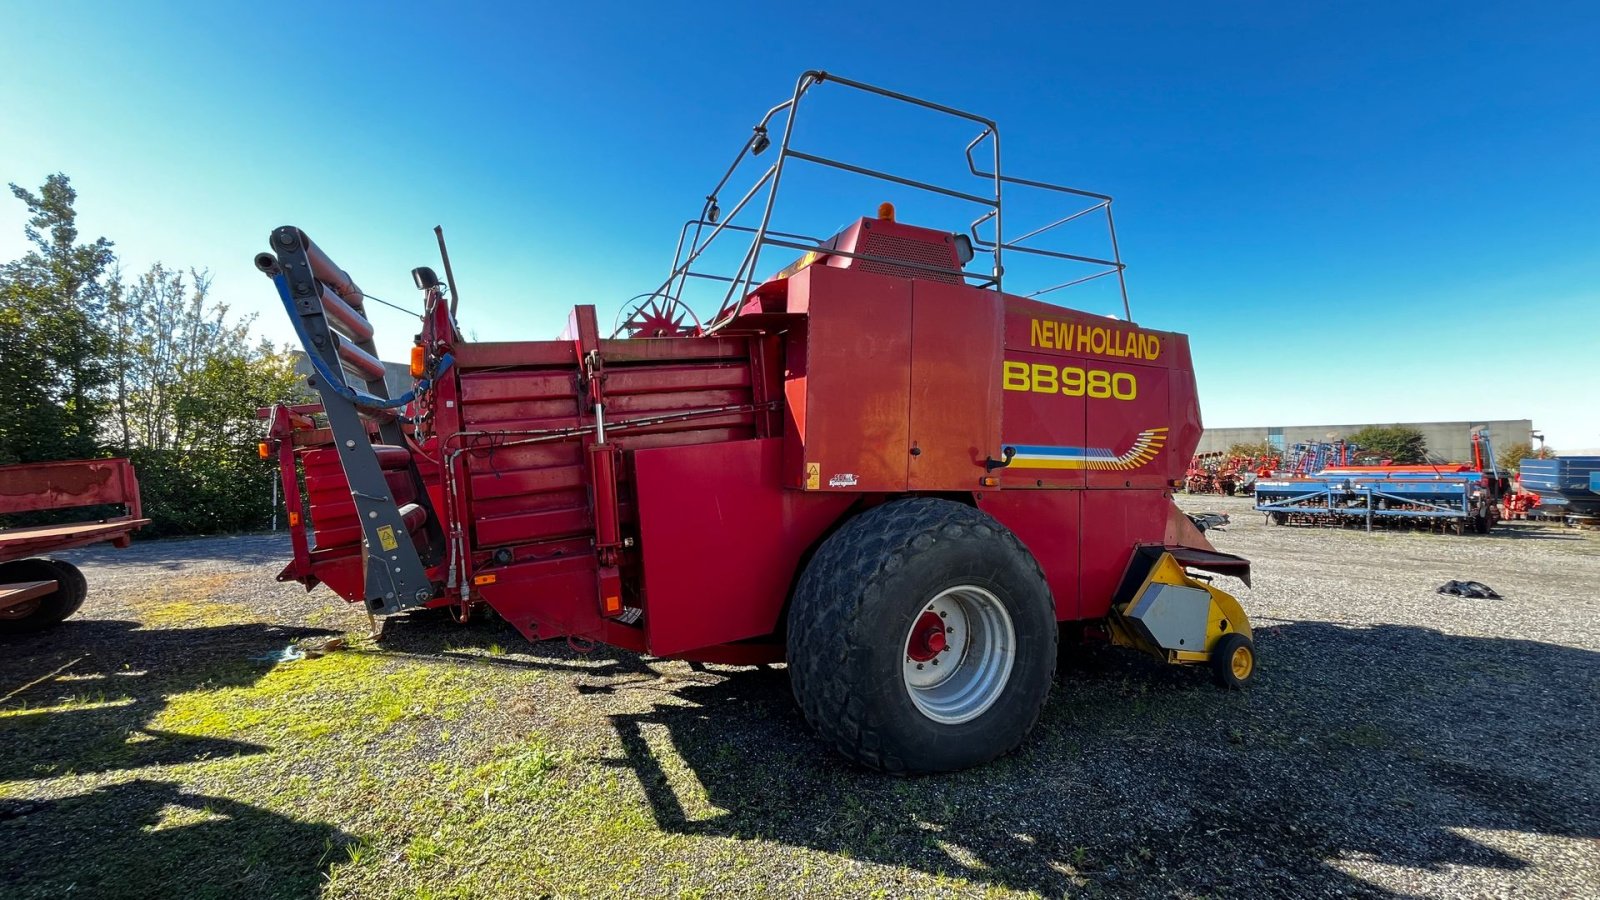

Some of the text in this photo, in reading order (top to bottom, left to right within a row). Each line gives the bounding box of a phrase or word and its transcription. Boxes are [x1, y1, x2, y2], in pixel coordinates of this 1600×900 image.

[1031, 318, 1160, 361] NEW HOLLAND
[1002, 360, 1137, 401] BB980
